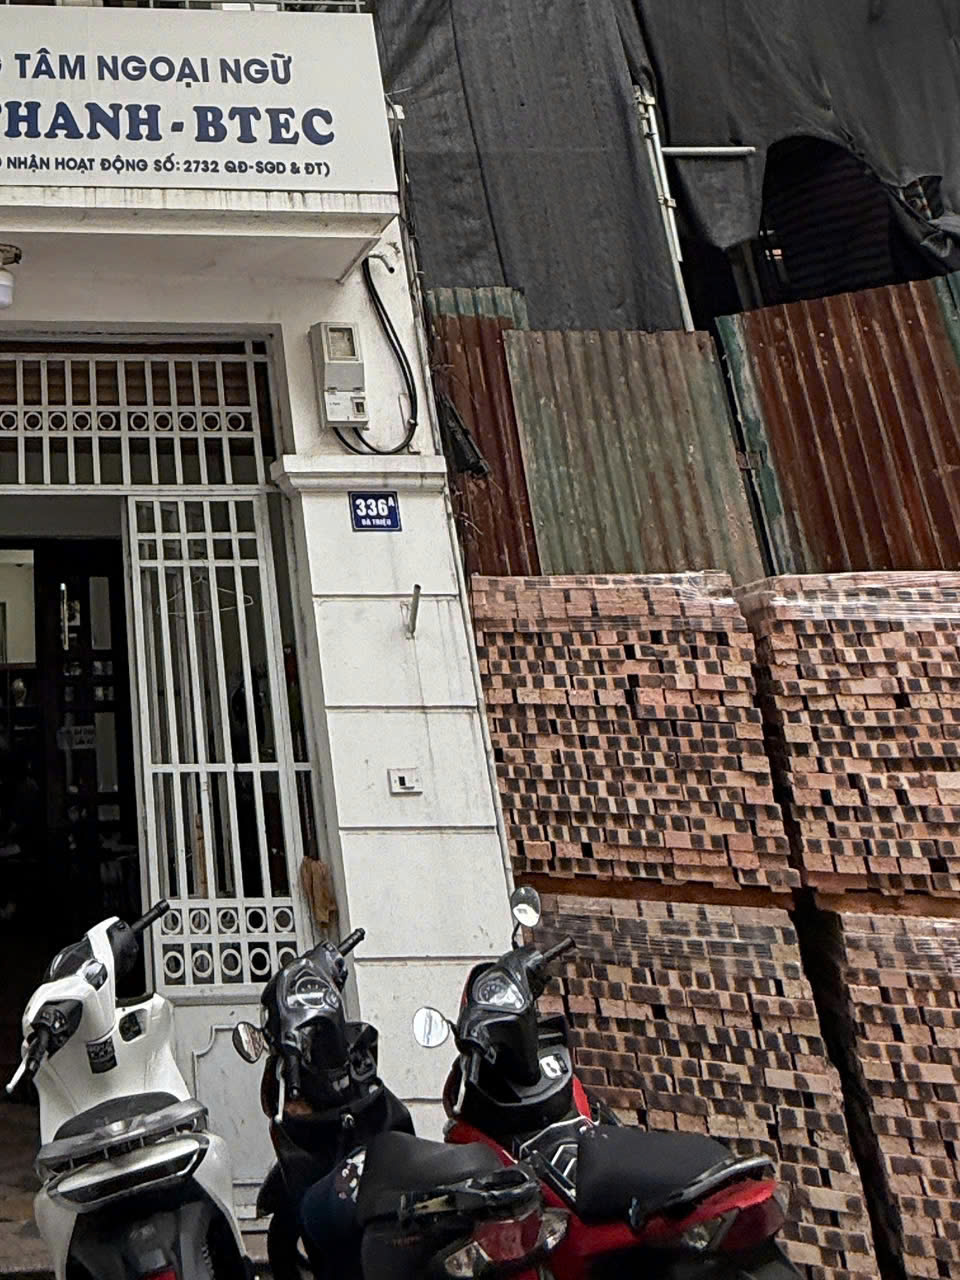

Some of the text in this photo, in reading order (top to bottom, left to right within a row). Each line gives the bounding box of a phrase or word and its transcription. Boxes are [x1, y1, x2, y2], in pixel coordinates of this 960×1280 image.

[14, 47, 86, 80] TÂM
[97, 55, 210, 88] NGOẠI
[220, 52, 292, 85] NGỮ
[7, 154, 50, 173] NHẬN
[55, 157, 95, 174] HOẠT
[100, 155, 148, 174] ĐỘNG
[183, 160, 220, 174] 2732
[290, 162, 301, 175] &
[304, 161, 331, 177] ĐT)
[355, 496, 395, 516] 336A
